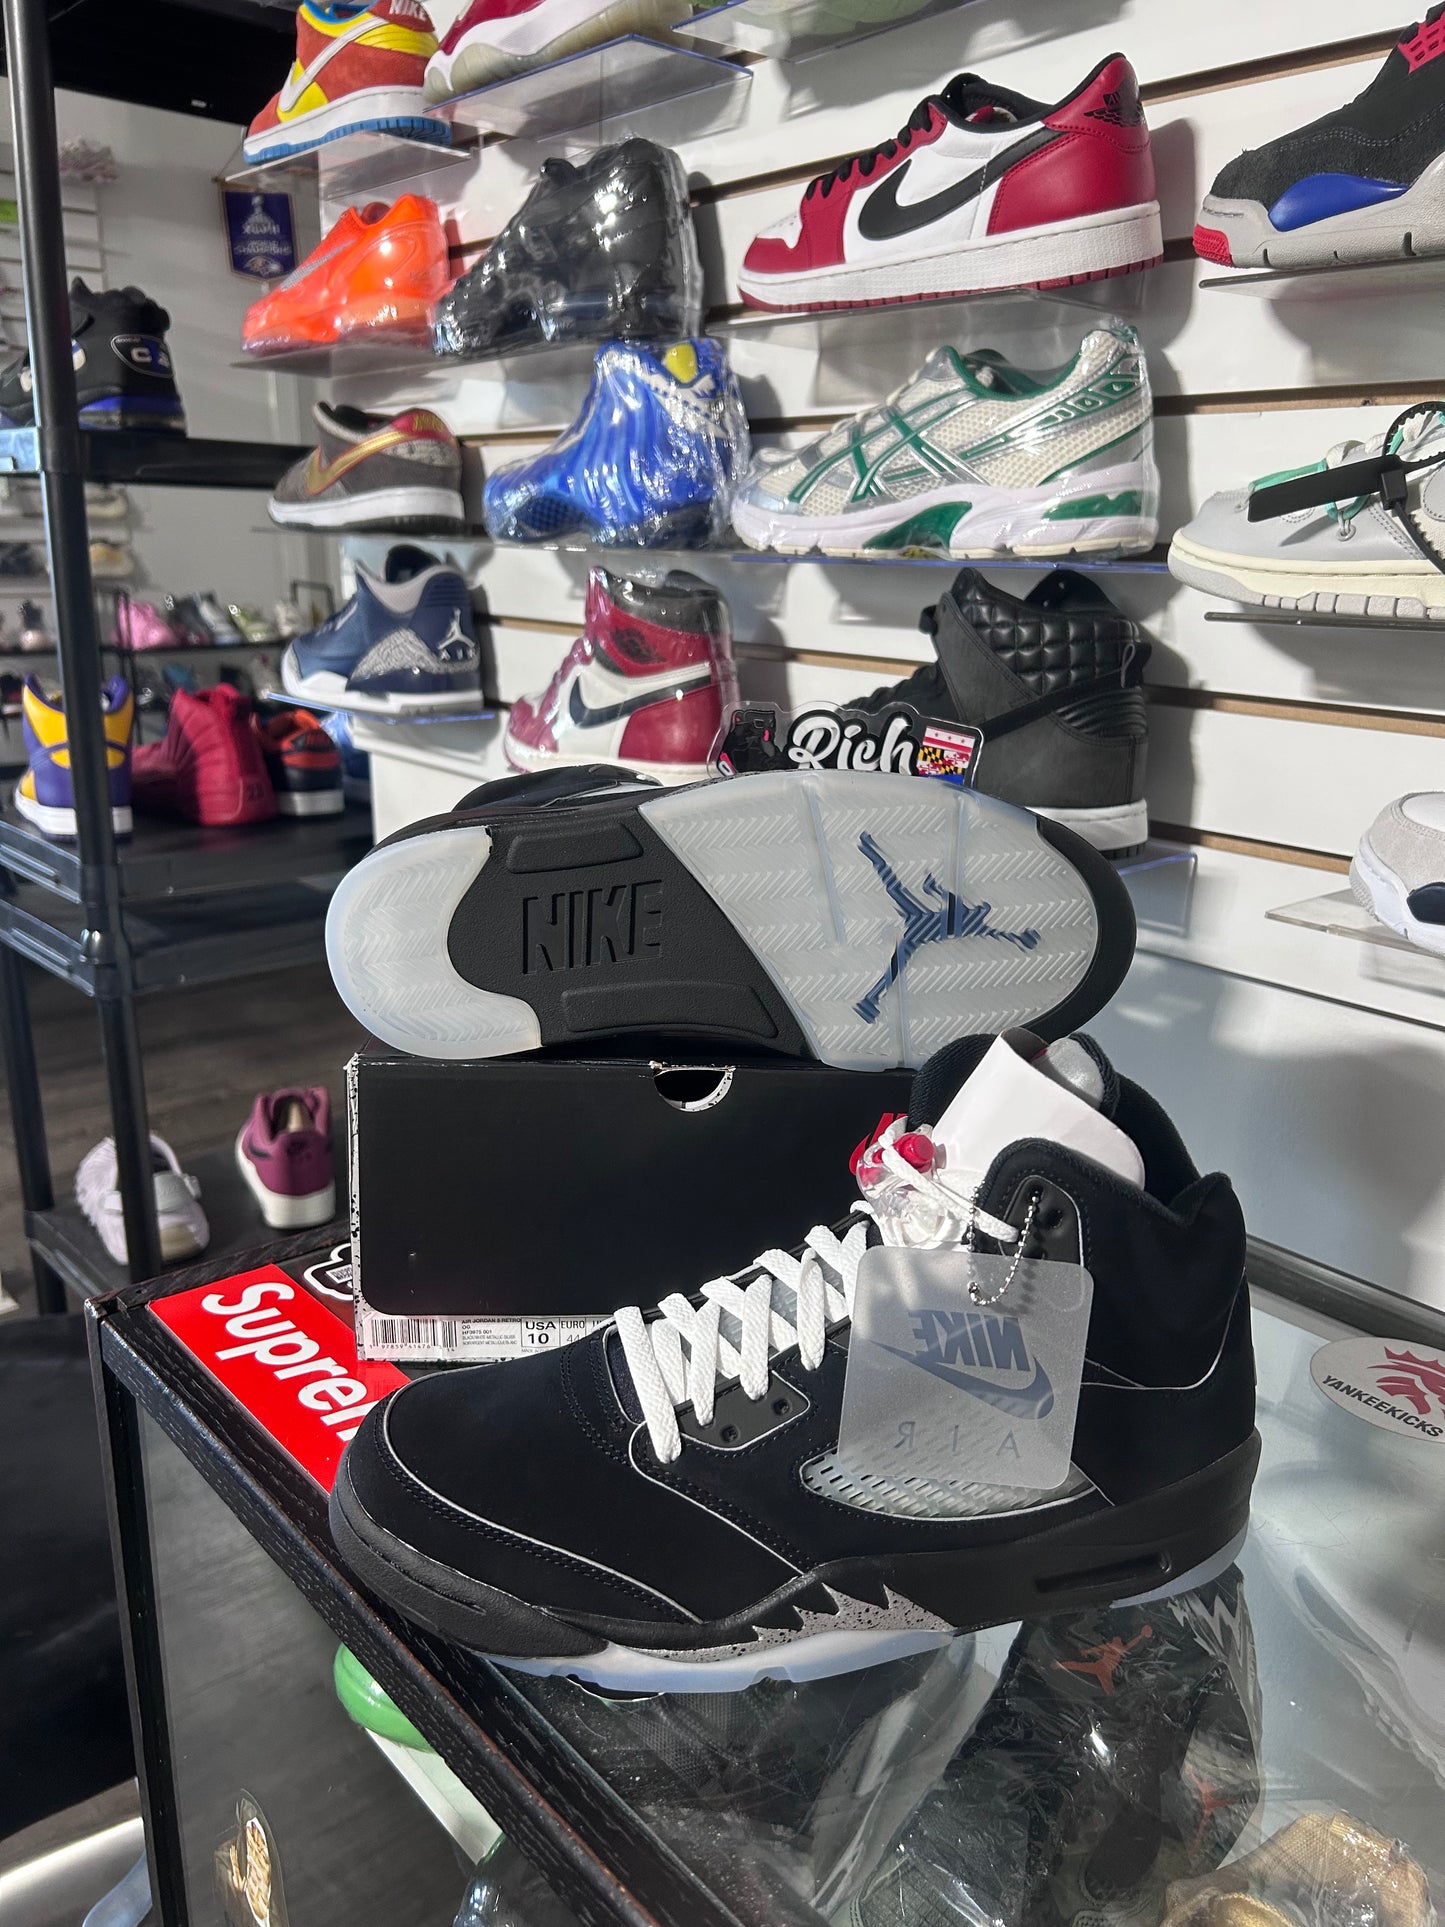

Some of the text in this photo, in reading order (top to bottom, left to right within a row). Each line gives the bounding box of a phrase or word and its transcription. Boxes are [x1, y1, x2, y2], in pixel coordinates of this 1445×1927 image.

[788, 716, 912, 776] Rich
[522, 879, 663, 975] NIKE
[525, 1320, 557, 1331] USA
[527, 1333, 549, 1344] 10
[560, 1320, 585, 1330] EURO
[201, 1282, 379, 1442] Supre
[1322, 1375, 1443, 1437] YANKEEKICKS
